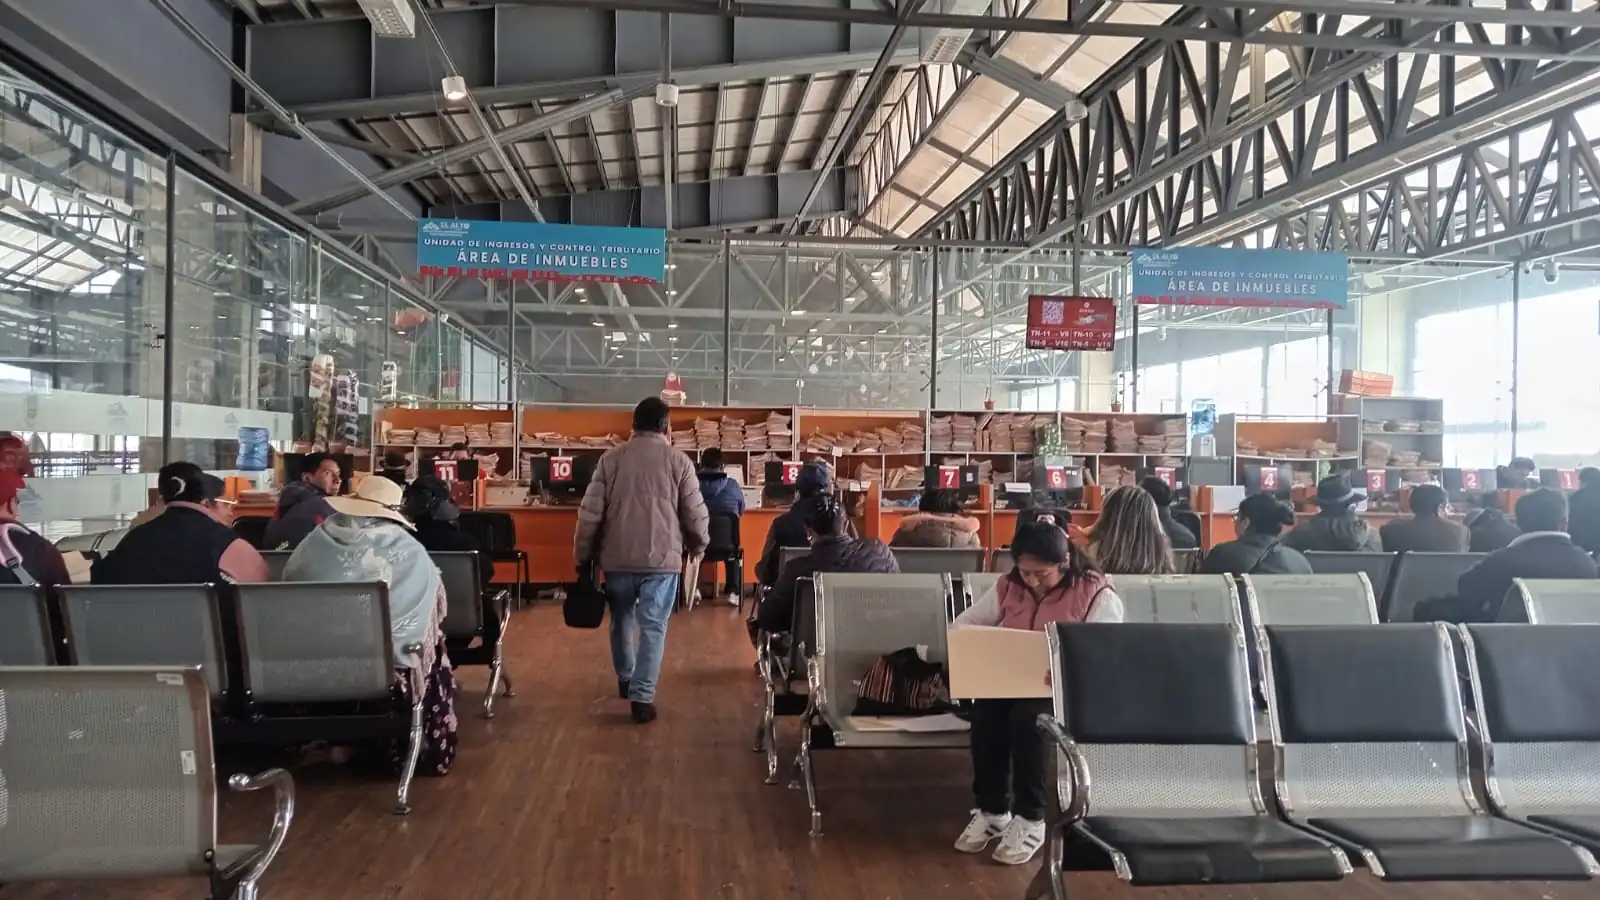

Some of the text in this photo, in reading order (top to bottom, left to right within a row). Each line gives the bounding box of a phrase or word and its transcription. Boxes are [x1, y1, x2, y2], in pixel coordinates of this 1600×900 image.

[424, 238, 464, 247] UNIDAD
[468, 240, 481, 248] DE
[485, 241, 535, 250] INGRESOS
[550, 243, 597, 252] CONTROL
[601, 246, 661, 255] TRIBUTARIO
[457, 247, 628, 269] ÁREA DE INMUEBLES
[1138, 268, 1174, 277] UNIDAD
[1191, 270, 1236, 278] INGRESOS
[1248, 271, 1289, 280] CONTROL
[1294, 273, 1345, 281] TRIBUTARIO
[1167, 276, 1317, 295] ÁREA DE INMUEBLES
[438, 466, 455, 481] 11
[552, 462, 571, 477] 10
[788, 467, 799, 481] 8
[944, 471, 955, 485] 7
[1051, 471, 1061, 485] 6
[1264, 472, 1274, 487] 4
[1371, 475, 1381, 489] 3
[1467, 473, 1477, 487] 2
